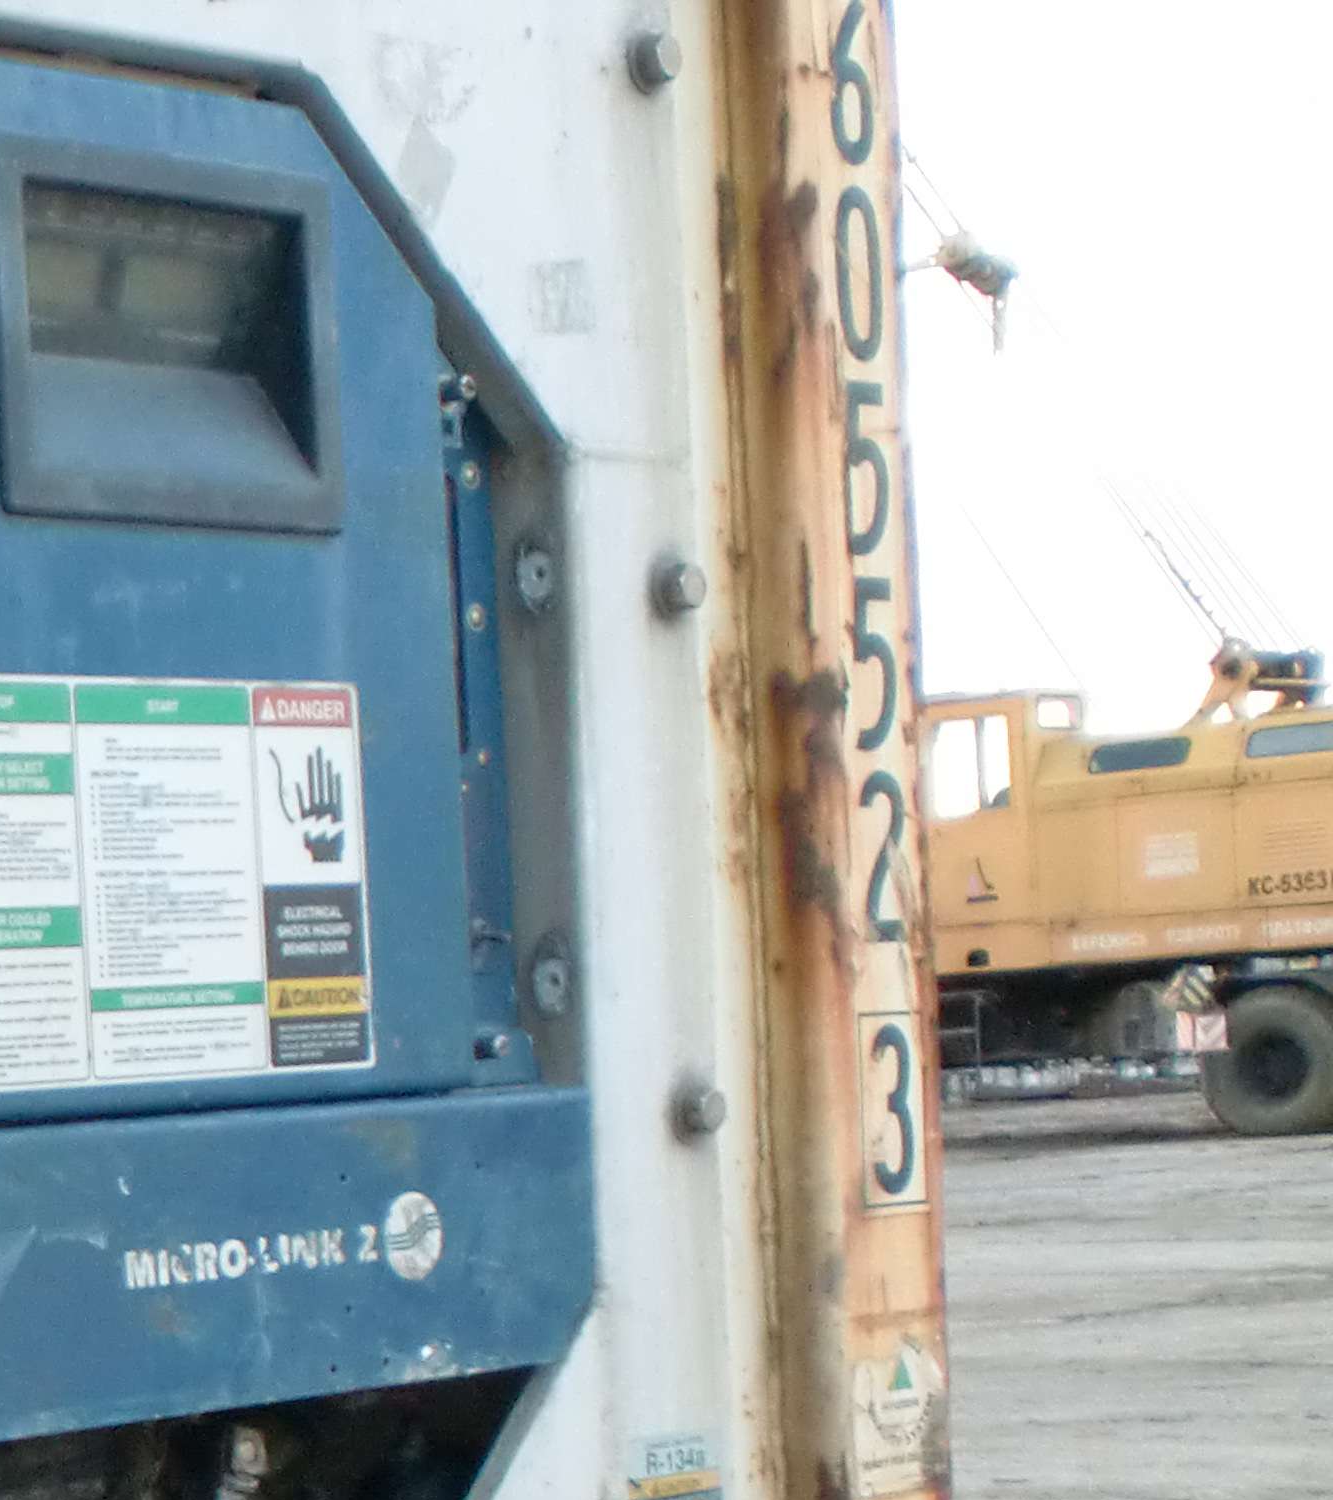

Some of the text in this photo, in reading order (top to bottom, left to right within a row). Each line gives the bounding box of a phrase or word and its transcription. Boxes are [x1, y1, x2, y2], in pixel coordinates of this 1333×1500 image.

[276, 698, 344, 720] DANGER
[293, 987, 360, 1006] CAUTION
[873, 1022, 915, 1194] 3
[358, 1224, 379, 1263] 2
